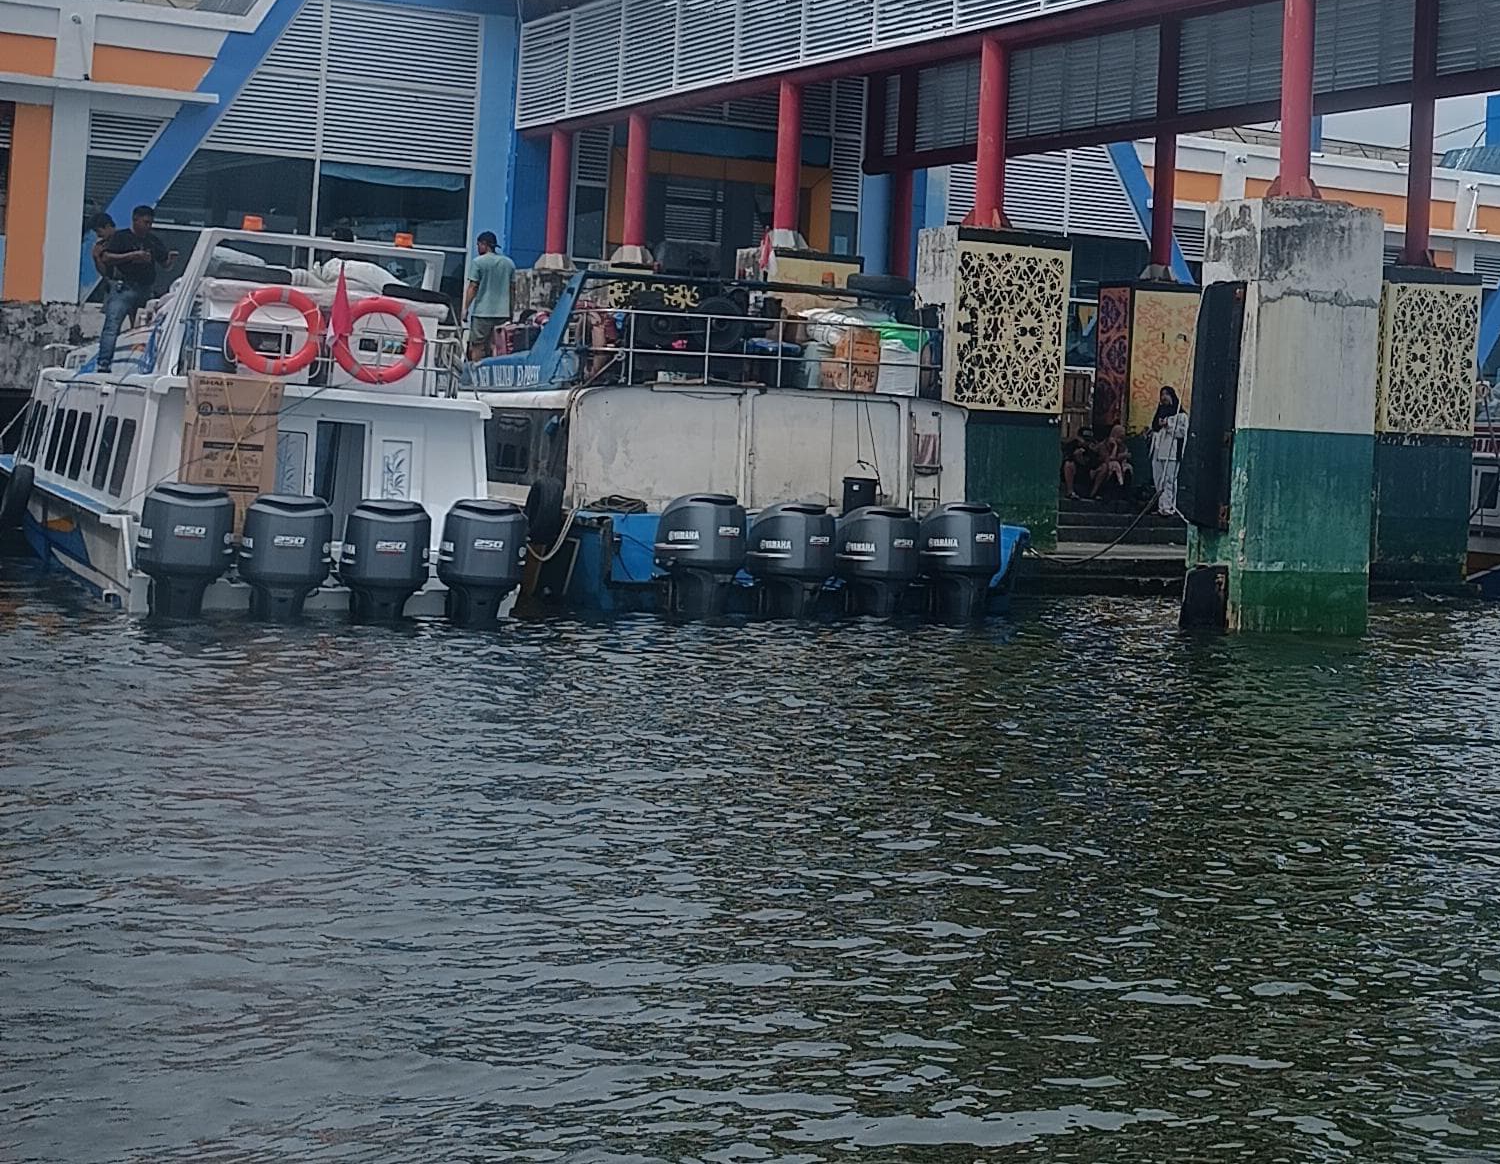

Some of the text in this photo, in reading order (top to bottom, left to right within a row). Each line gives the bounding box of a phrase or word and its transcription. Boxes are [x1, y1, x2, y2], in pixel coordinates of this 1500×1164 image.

[173, 524, 206, 536] 250
[473, 538, 504, 549] 250
[765, 540, 792, 550] YAMAHA
